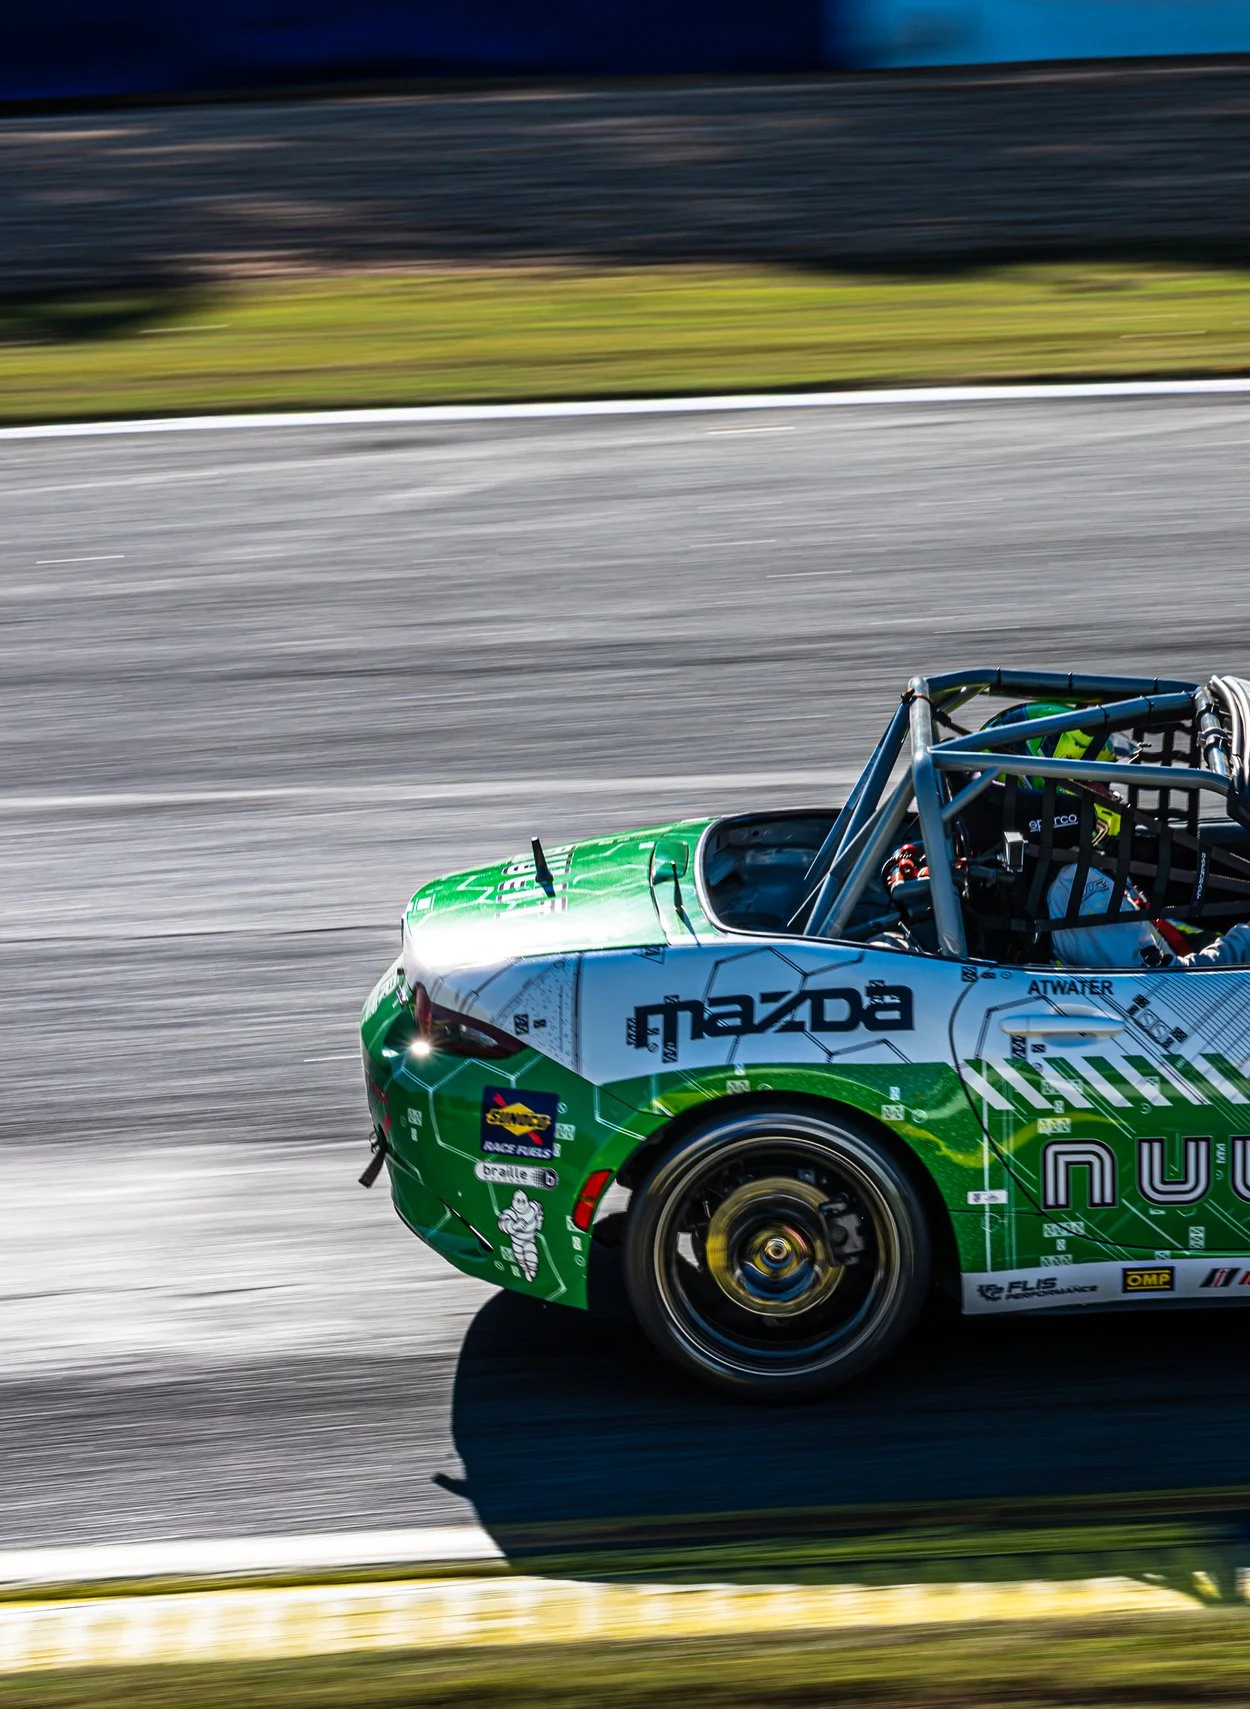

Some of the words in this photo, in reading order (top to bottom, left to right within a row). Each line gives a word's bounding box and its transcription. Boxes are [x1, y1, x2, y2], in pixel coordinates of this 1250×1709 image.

[1029, 813, 1078, 832] sprco
[1027, 980, 1114, 995] ATWATER
[486, 1109, 551, 1129] SUNOCO
[483, 1140, 516, 1154] RACE
[516, 1144, 552, 1159] FUELS
[483, 1164, 528, 1180] braille
[1007, 1277, 1058, 1292] FLIS
[1126, 1274, 1171, 1286] OMP
[1005, 1284, 1098, 1300] PERFORMANCE
